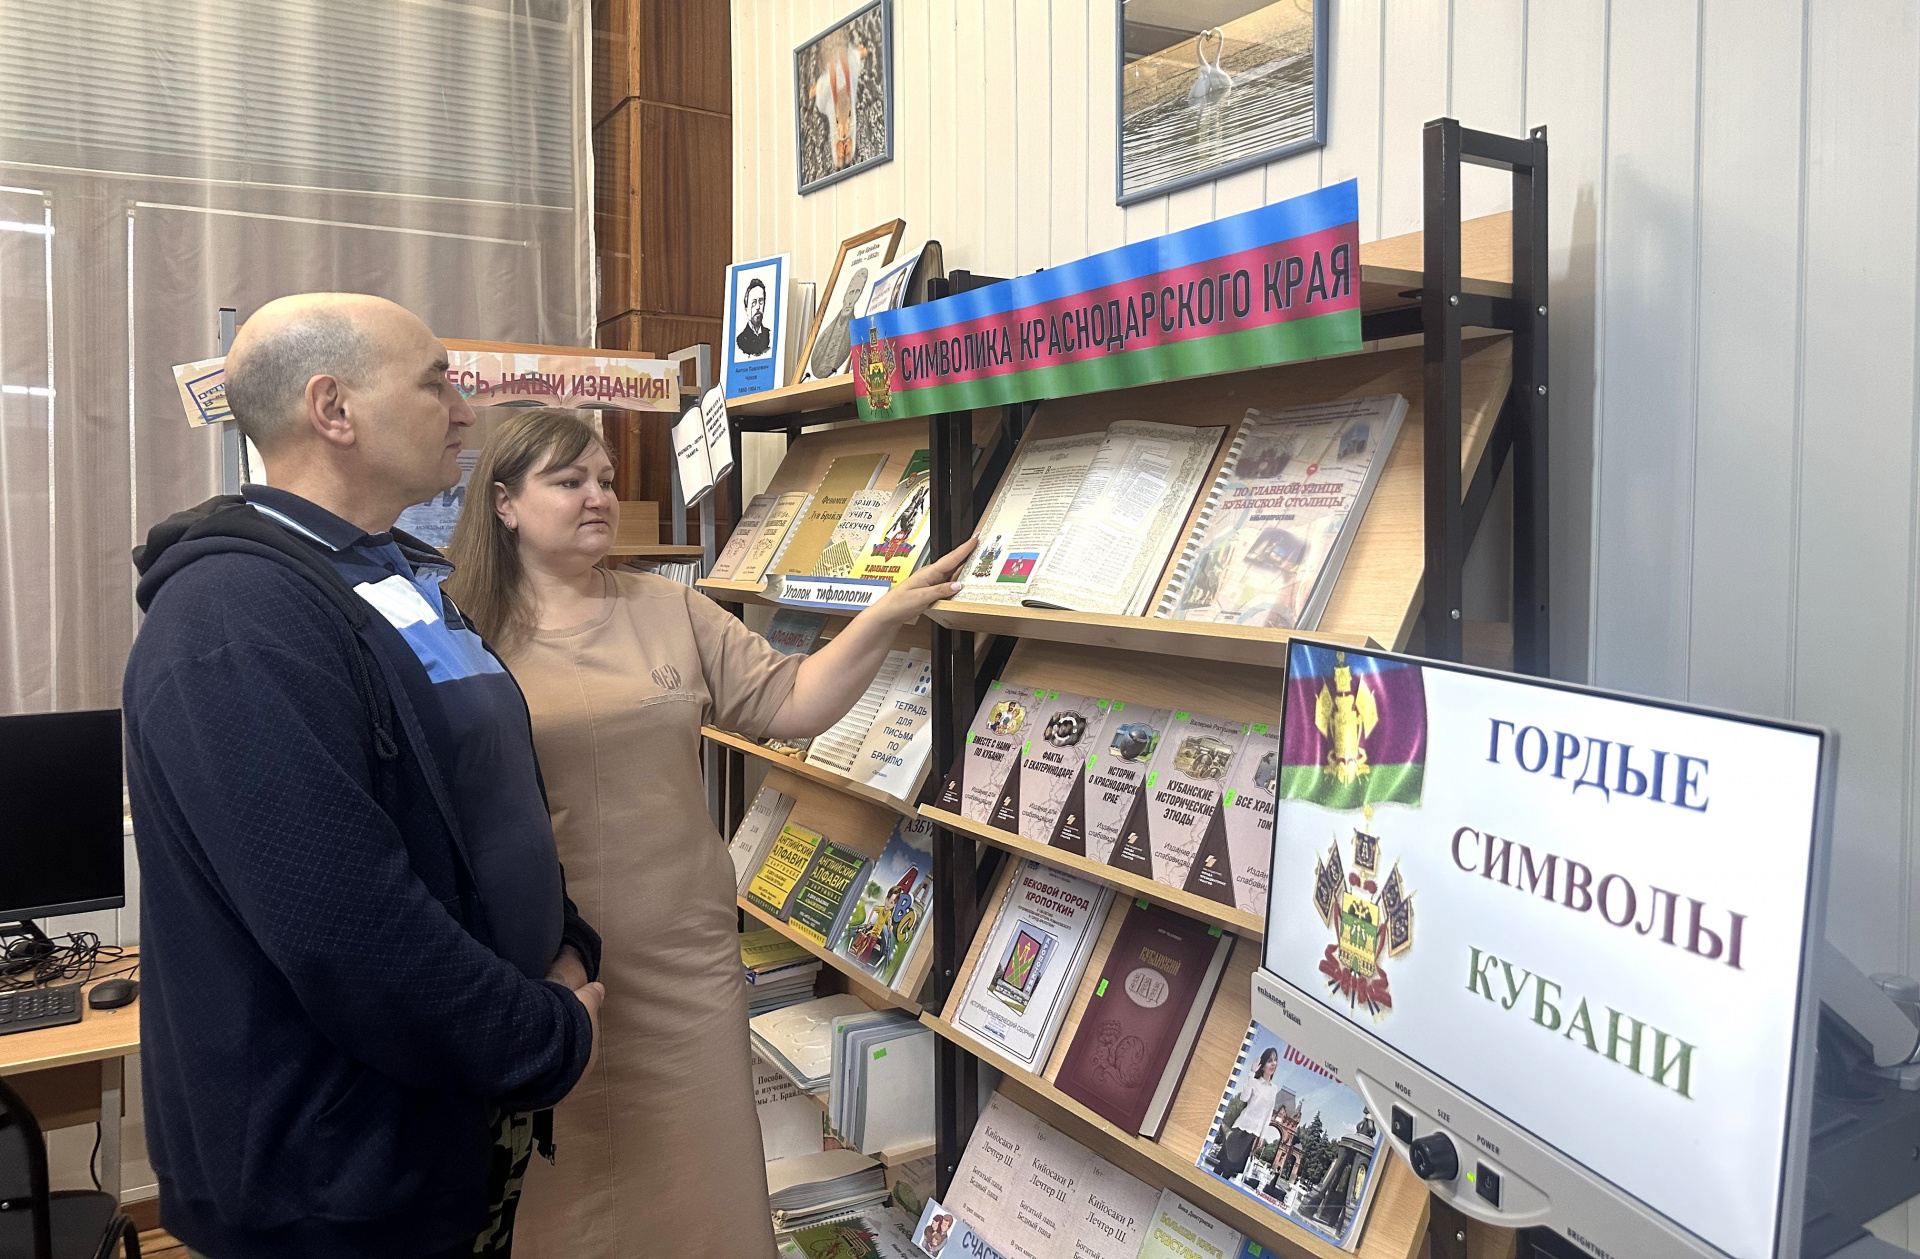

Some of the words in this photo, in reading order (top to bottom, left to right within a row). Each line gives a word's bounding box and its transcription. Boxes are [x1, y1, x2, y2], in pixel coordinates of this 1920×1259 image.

[902, 325, 1013, 381] СИМВОЛИКА
[1020, 269, 1250, 359] КРАСНОДАРСКОГО
[1264, 242, 1351, 312] КРАЯ
[502, 372, 565, 399] НАШИ
[572, 375, 670, 402] ИЗДАНИЯ!
[1233, 487, 1249, 497] ПО
[1250, 482, 1299, 496] ГЛАВНОЙ
[1301, 482, 1344, 496] УЛИЦЕ
[822, 496, 847, 505] Феномен
[1221, 497, 1283, 510] КУБАНСКОЙ
[1284, 497, 1346, 509] СТОЛИЦЫ
[849, 511, 873, 520] УЧИТЬ
[837, 522, 875, 532] НЕСКУЧНО
[783, 583, 811, 600] Уголок
[816, 585, 872, 604] тифлологии
[894, 700, 928, 716] ТЕТРАДЬ
[896, 717, 914, 728] ДЛЯ
[1189, 718, 1213, 730] Валерий
[883, 726, 914, 742] ПИСЬМА
[972, 735, 991, 748] ВМЕСТЕ
[996, 741, 1012, 752] НАМИ
[886, 741, 899, 751] ПО
[974, 747, 983, 757] ПО
[870, 750, 903, 767] БРАЙЛЮ
[1042, 751, 1064, 763] ФАКТЫ
[1484, 717, 1711, 814] ГОРДЫЕ
[1023, 759, 1029, 768] О
[1028, 761, 1074, 779] ЕКАТЕРИНОДАРЕ
[1088, 774, 1094, 783] О
[1107, 766, 1136, 780] ИСТОРИИ
[1102, 792, 1120, 804] КРАЕ
[1166, 779, 1214, 802] КУБАНСКИЕ
[1155, 791, 1216, 817] ИСТОРИЧЕСКИЕ
[1235, 795, 1252, 809] ВСЕ
[1163, 808, 1195, 826] ЭТЮДЫ
[1257, 818, 1273, 831] ТОМ
[778, 835, 815, 858] АНГЛИЙСКИЙ
[1164, 842, 1190, 857] Издание
[772, 844, 809, 870] АЛФАВИТ
[818, 855, 857, 879] АНГЛИЙСКИЙ
[810, 866, 850, 892] АЛФАВИТ
[1023, 877, 1059, 898] ВЕКОВОЙ
[1059, 890, 1090, 911] ГОРОД
[1450, 824, 1749, 971] СИМВОЛЫ
[1025, 891, 1075, 918] КРОПОТКИН
[1257, 985, 1286, 1008] enhanced
[1282, 1008, 1302, 1027] vision
[1465, 944, 1699, 1102] КУБАНИ
[1017, 1025, 1036, 1039] СБОРНИК
[1324, 1061, 1339, 1075] LIGHT
[758, 1073, 785, 1084] Пособи
[780, 1090, 804, 1101] Брайл
[1394, 1081, 1412, 1098] MODE
[1437, 1108, 1451, 1124] SIZE
[985, 1126, 1013, 1150] Кийосаки
[1013, 1145, 1021, 1157] Р.,
[1037, 1132, 1047, 1141] 16+
[1476, 1134, 1500, 1156] POWER
[982, 1141, 1003, 1161] Лечтер
[1003, 1156, 1013, 1168] Ш.
[972, 1166, 991, 1183] Богатый
[991, 1179, 1003, 1193] папа,
[1031, 1157, 1067, 1186] Кийосаки
[1067, 1179, 1076, 1194] Р.,
[1092, 1166, 1103, 1176] 16+
[969, 1176, 987, 1194] Бедный
[988, 1189, 999, 1201] папа
[1029, 1174, 1055, 1197] Лечтер
[1056, 1189, 1067, 1204] Ш.
[1019, 1199, 1043, 1220] Богатый
[1042, 1216, 1056, 1230] папа,
[1087, 1194, 1126, 1225] Кийосаки
[1126, 1218, 1136, 1233] Р.,
[1178, 1203, 1188, 1214] Вика
[1187, 1210, 1214, 1230] Дмитриева
[1017, 1211, 1038, 1231] Бедный
[1038, 1227, 1052, 1239] папа
[1085, 1211, 1114, 1237] Лечтер
[1114, 1228, 1126, 1244] Ш.
[1075, 1239, 1102, 1259] Богатый
